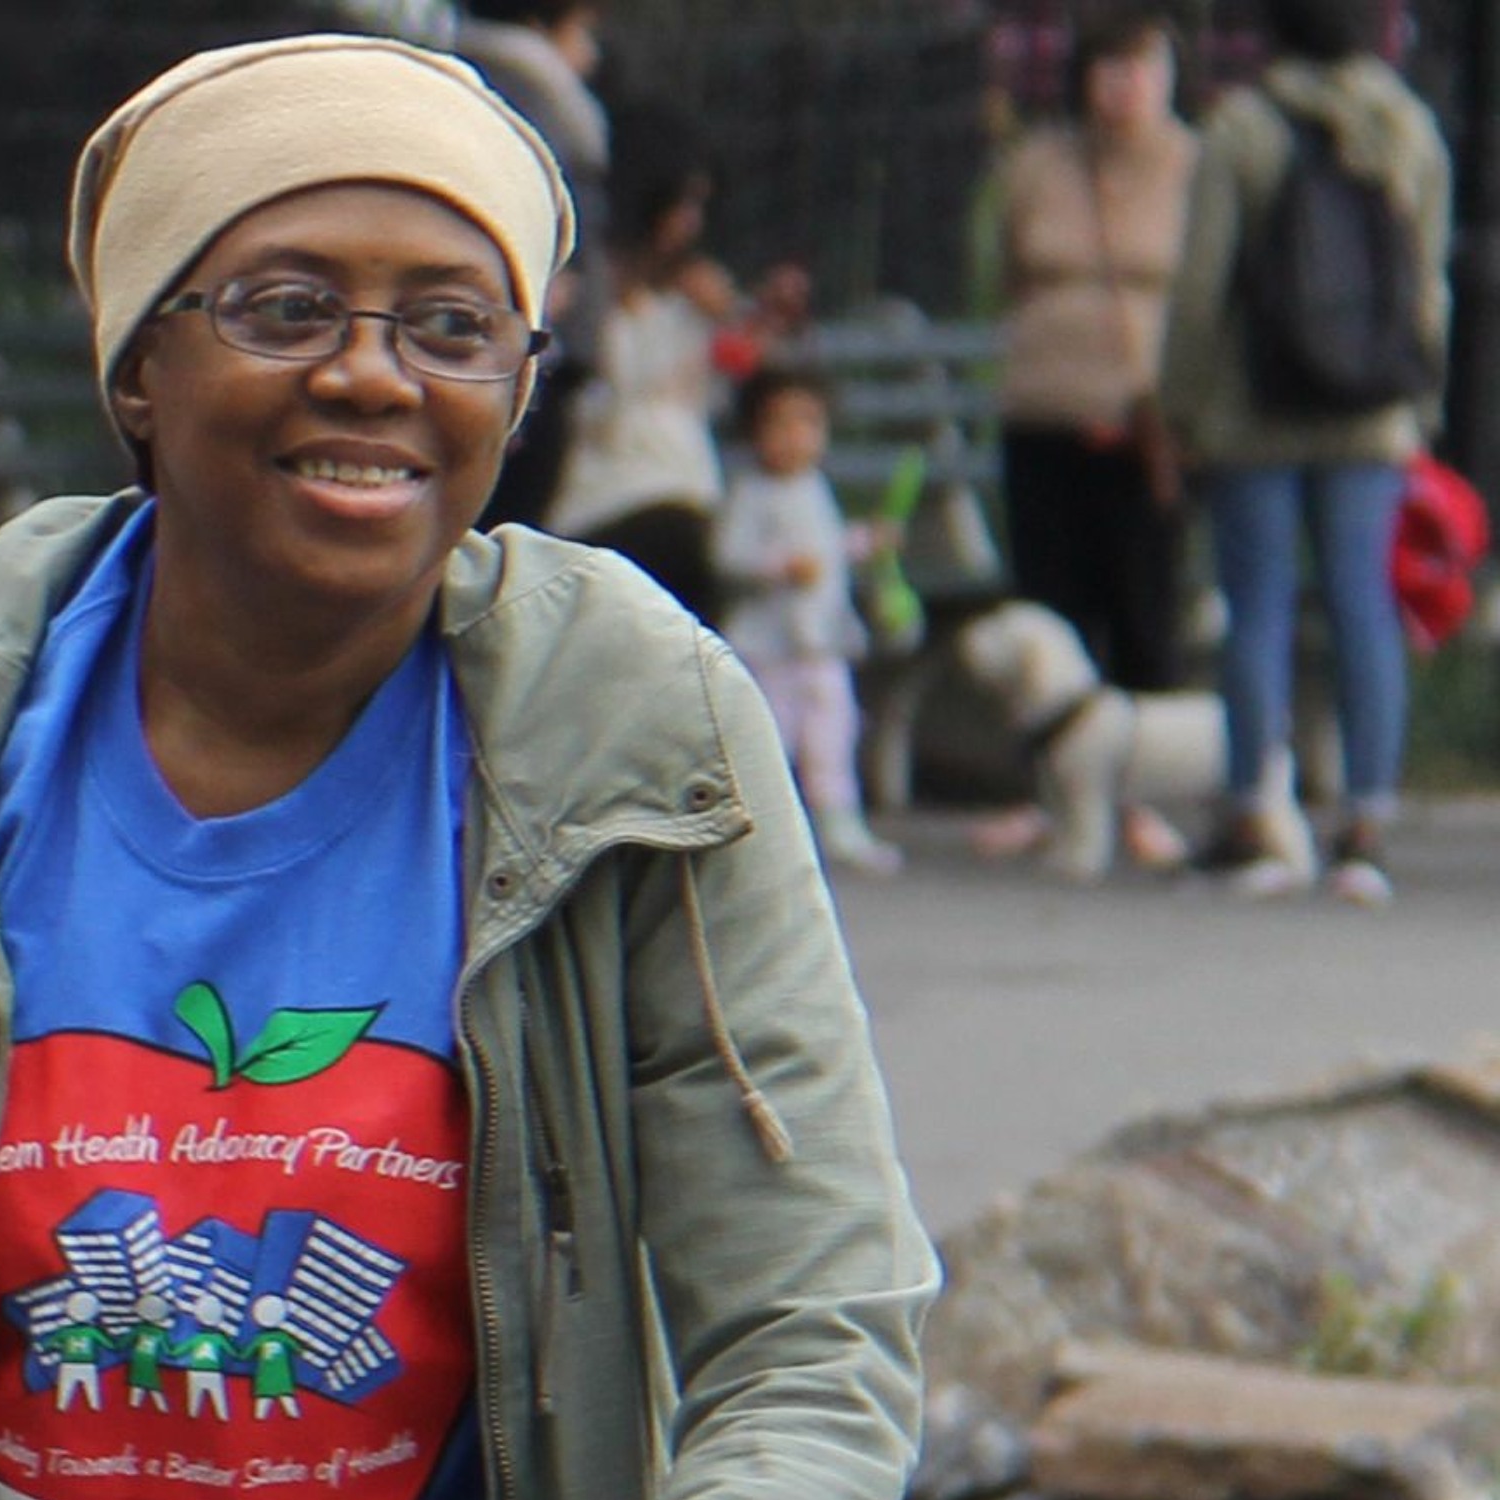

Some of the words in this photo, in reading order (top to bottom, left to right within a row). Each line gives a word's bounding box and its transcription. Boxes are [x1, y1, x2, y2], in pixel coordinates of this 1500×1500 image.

[50, 1113, 159, 1168] Health
[169, 1117, 306, 1175] Advocacy
[307, 1126, 462, 1189] Partners
[314, 1447, 347, 1489] of
